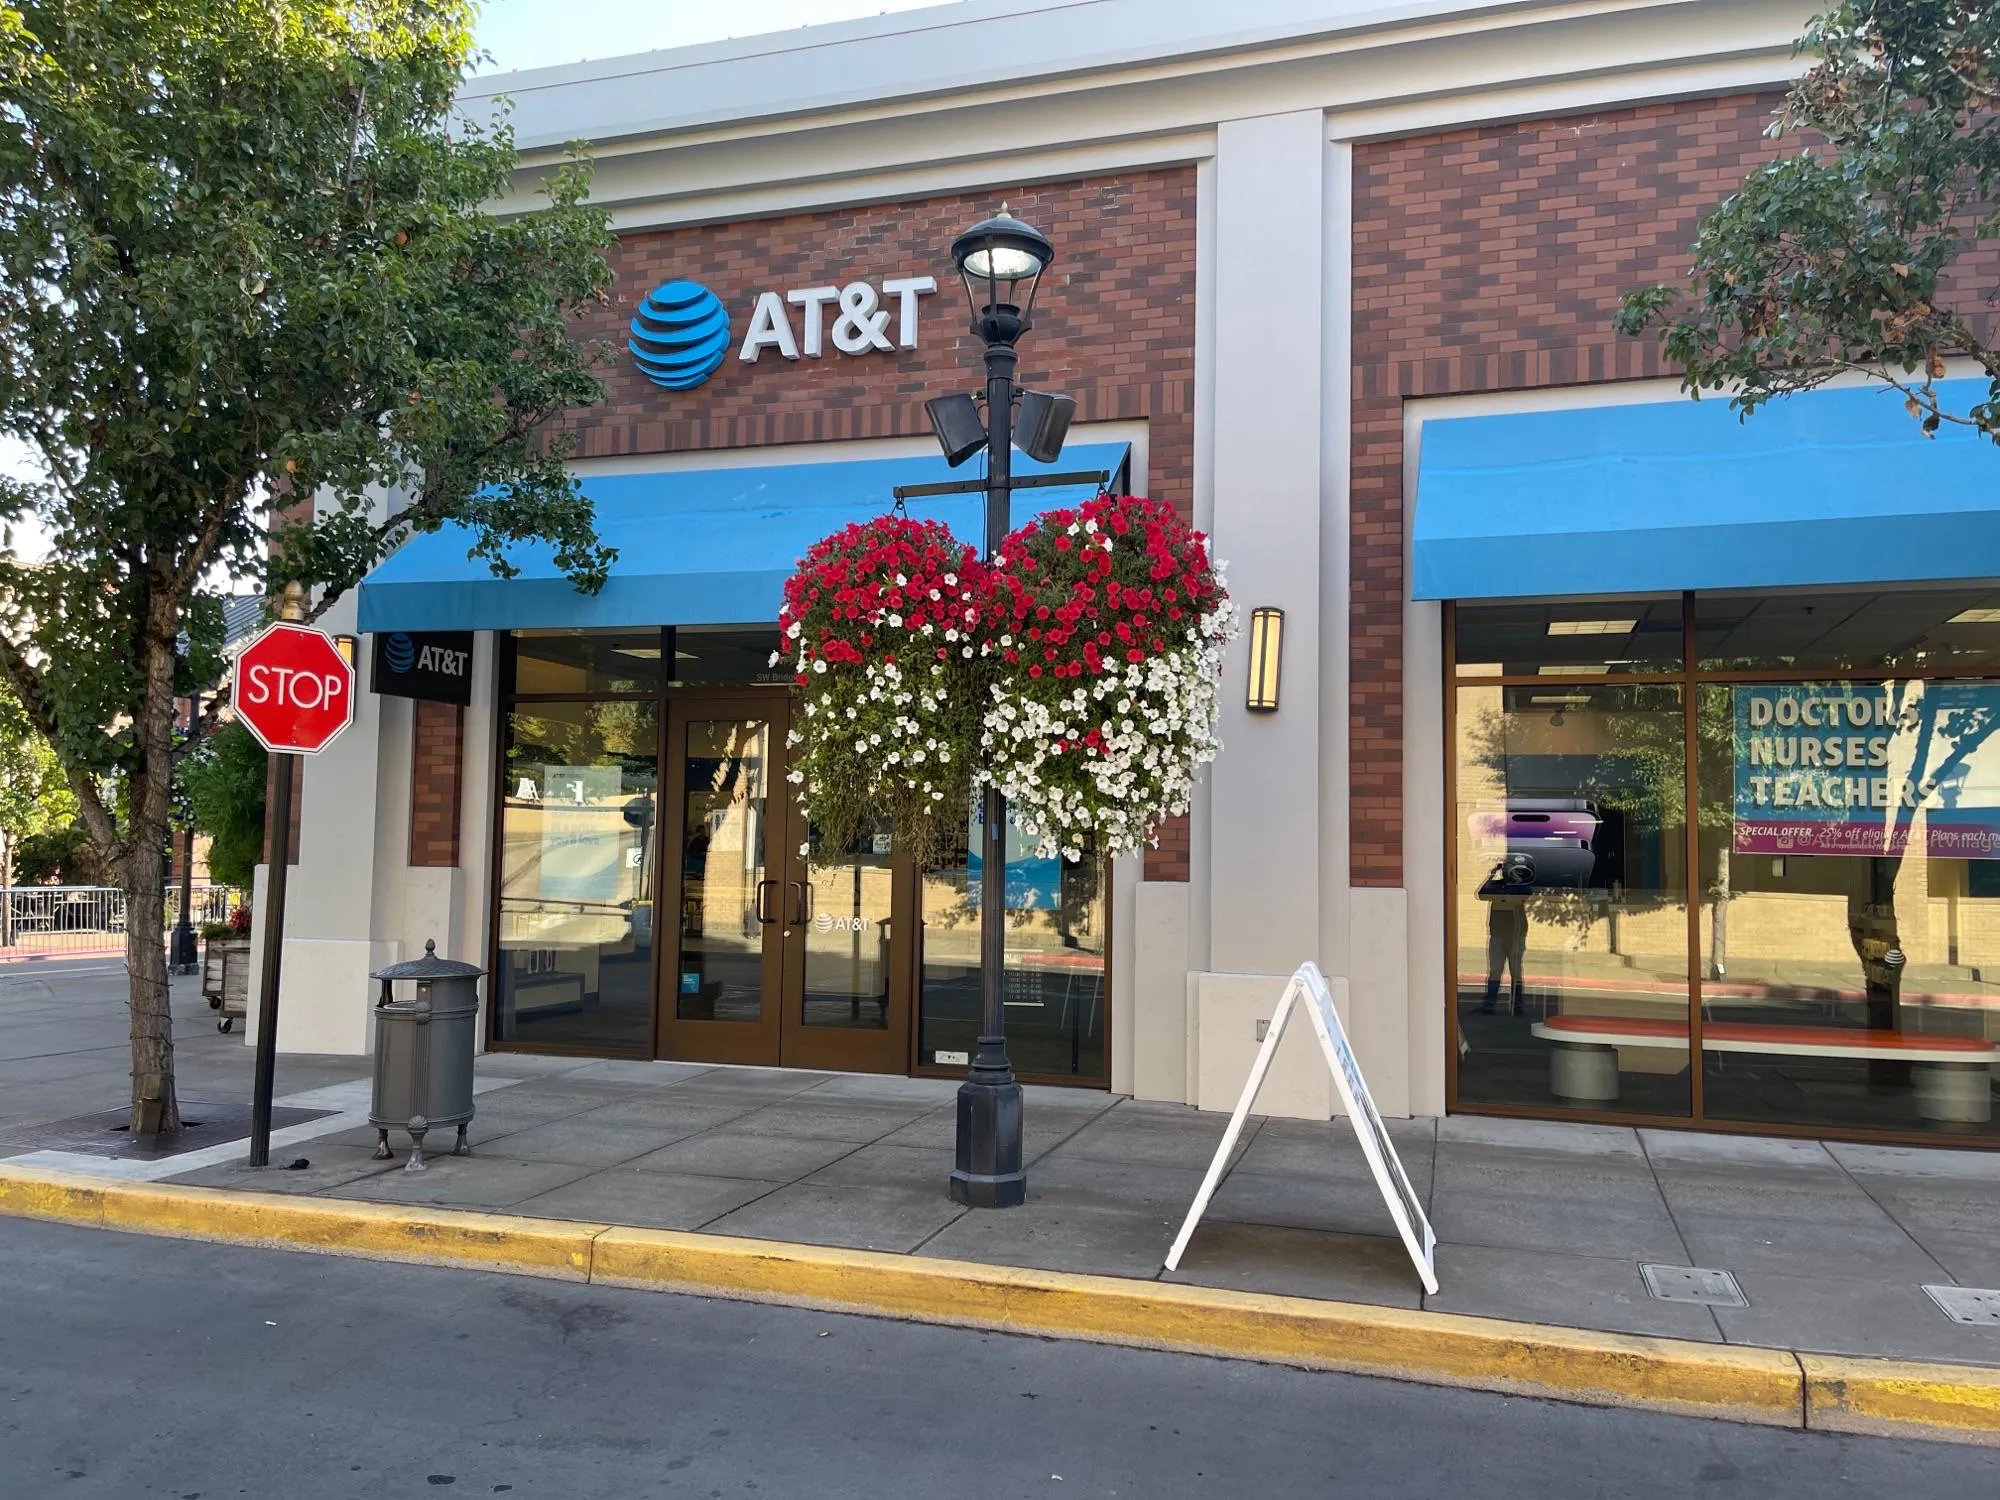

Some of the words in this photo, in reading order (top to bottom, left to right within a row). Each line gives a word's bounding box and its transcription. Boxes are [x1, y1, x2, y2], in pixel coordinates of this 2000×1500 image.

[739, 276, 937, 363] AT&T
[417, 645, 468, 676] AT&T
[248, 665, 342, 711] STOP
[756, 673, 770, 682] SW
[1750, 696, 1919, 727] DOCTORS
[1750, 736, 1888, 767] NURSES
[1750, 776, 1938, 808] TEACHERS
[1740, 826, 1778, 836] SPECIAL
[1781, 827, 1814, 837] OFFER.
[1820, 827, 1842, 838] 25%
[1845, 828, 1861, 839] off
[1863, 828, 1898, 841] eligie
[1931, 829, 1959, 840] Plans
[1961, 830, 1986, 841] each
[836, 917, 870, 931] AT&T
